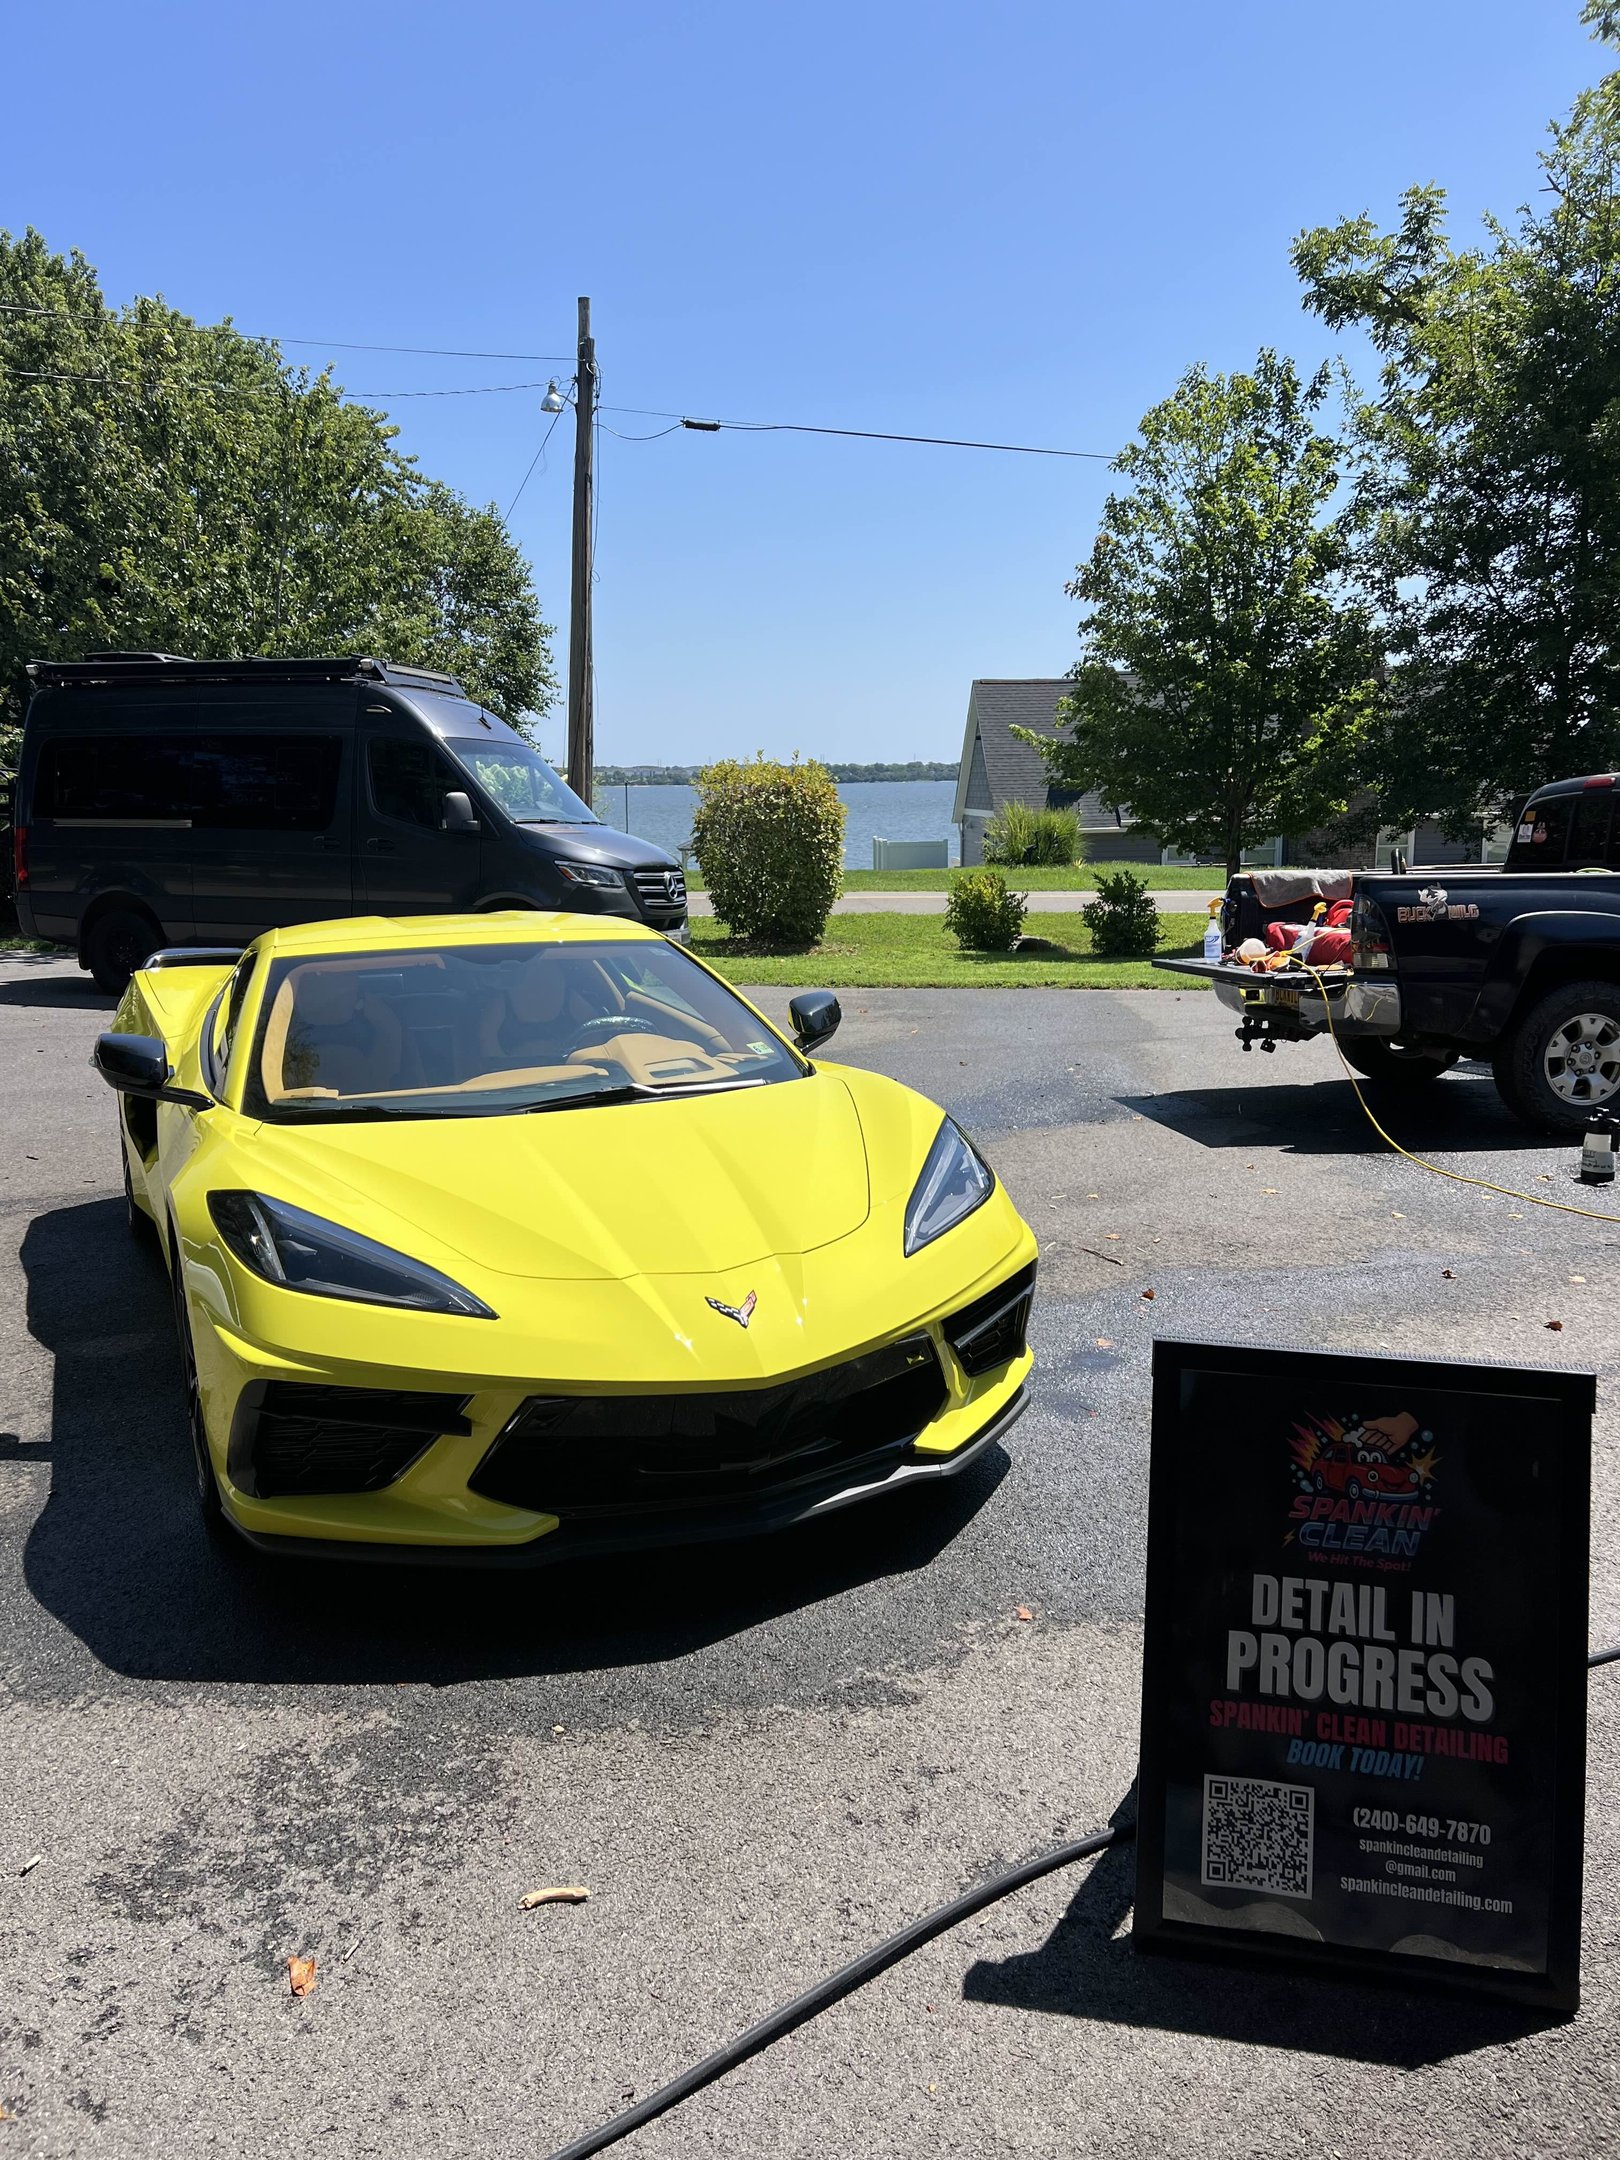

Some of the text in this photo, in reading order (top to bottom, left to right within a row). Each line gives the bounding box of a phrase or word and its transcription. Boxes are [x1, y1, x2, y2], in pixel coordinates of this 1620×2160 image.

[1397, 906, 1434, 923] BUCK
[1288, 1495, 1440, 1529] SPANKIN'
[1299, 1522, 1419, 1555] CLEAN
[1308, 1551, 1410, 1572] We Hit The Spot!
[1251, 1573, 1453, 1646] DETAIL IN
[1226, 1630, 1495, 1721] PROGRESS
[1208, 1699, 1509, 1764] SPANKIN' CLEAN DETAILING
[1286, 1738, 1424, 1779] BOOK TODAY!
[1352, 1807, 1490, 1844] (240)-649-7870
[1359, 1838, 1482, 1867] spankincleandetailing
[1385, 1860, 1455, 1881] @gmail.com
[1340, 1876, 1512, 1912] spankincleandetailing.com
